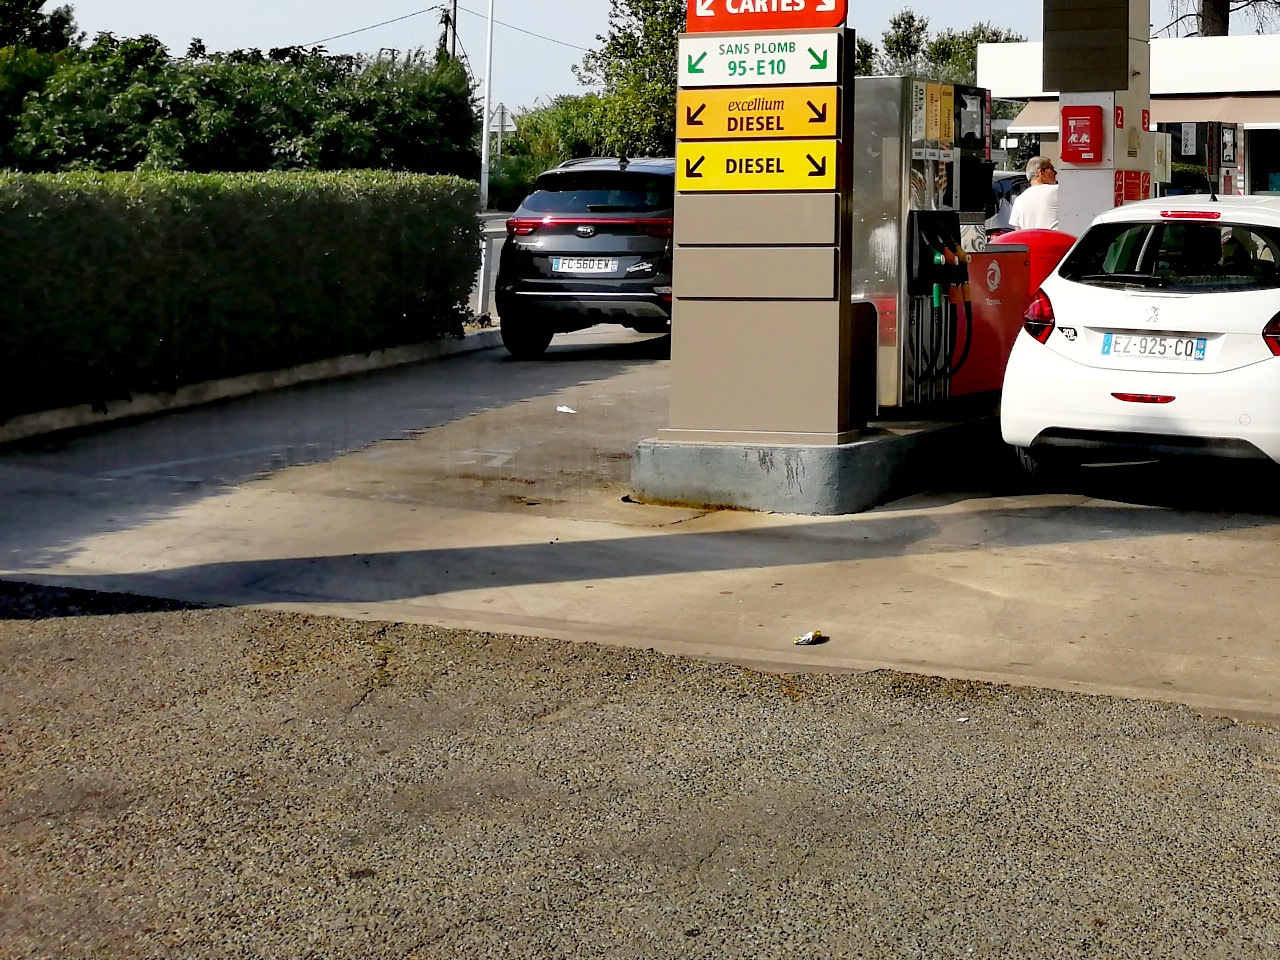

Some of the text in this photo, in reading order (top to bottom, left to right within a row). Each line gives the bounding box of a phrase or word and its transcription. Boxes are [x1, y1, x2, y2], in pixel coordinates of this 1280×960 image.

[718, 41, 796, 56] SANS PLOMB
[727, 58, 786, 77] 95-E10
[727, 97, 785, 113] excellium
[727, 116, 785, 132] DIESEL
[1117, 109, 1122, 125] 2
[1144, 113, 1149, 128] 3
[726, 157, 785, 174] DIESEL
